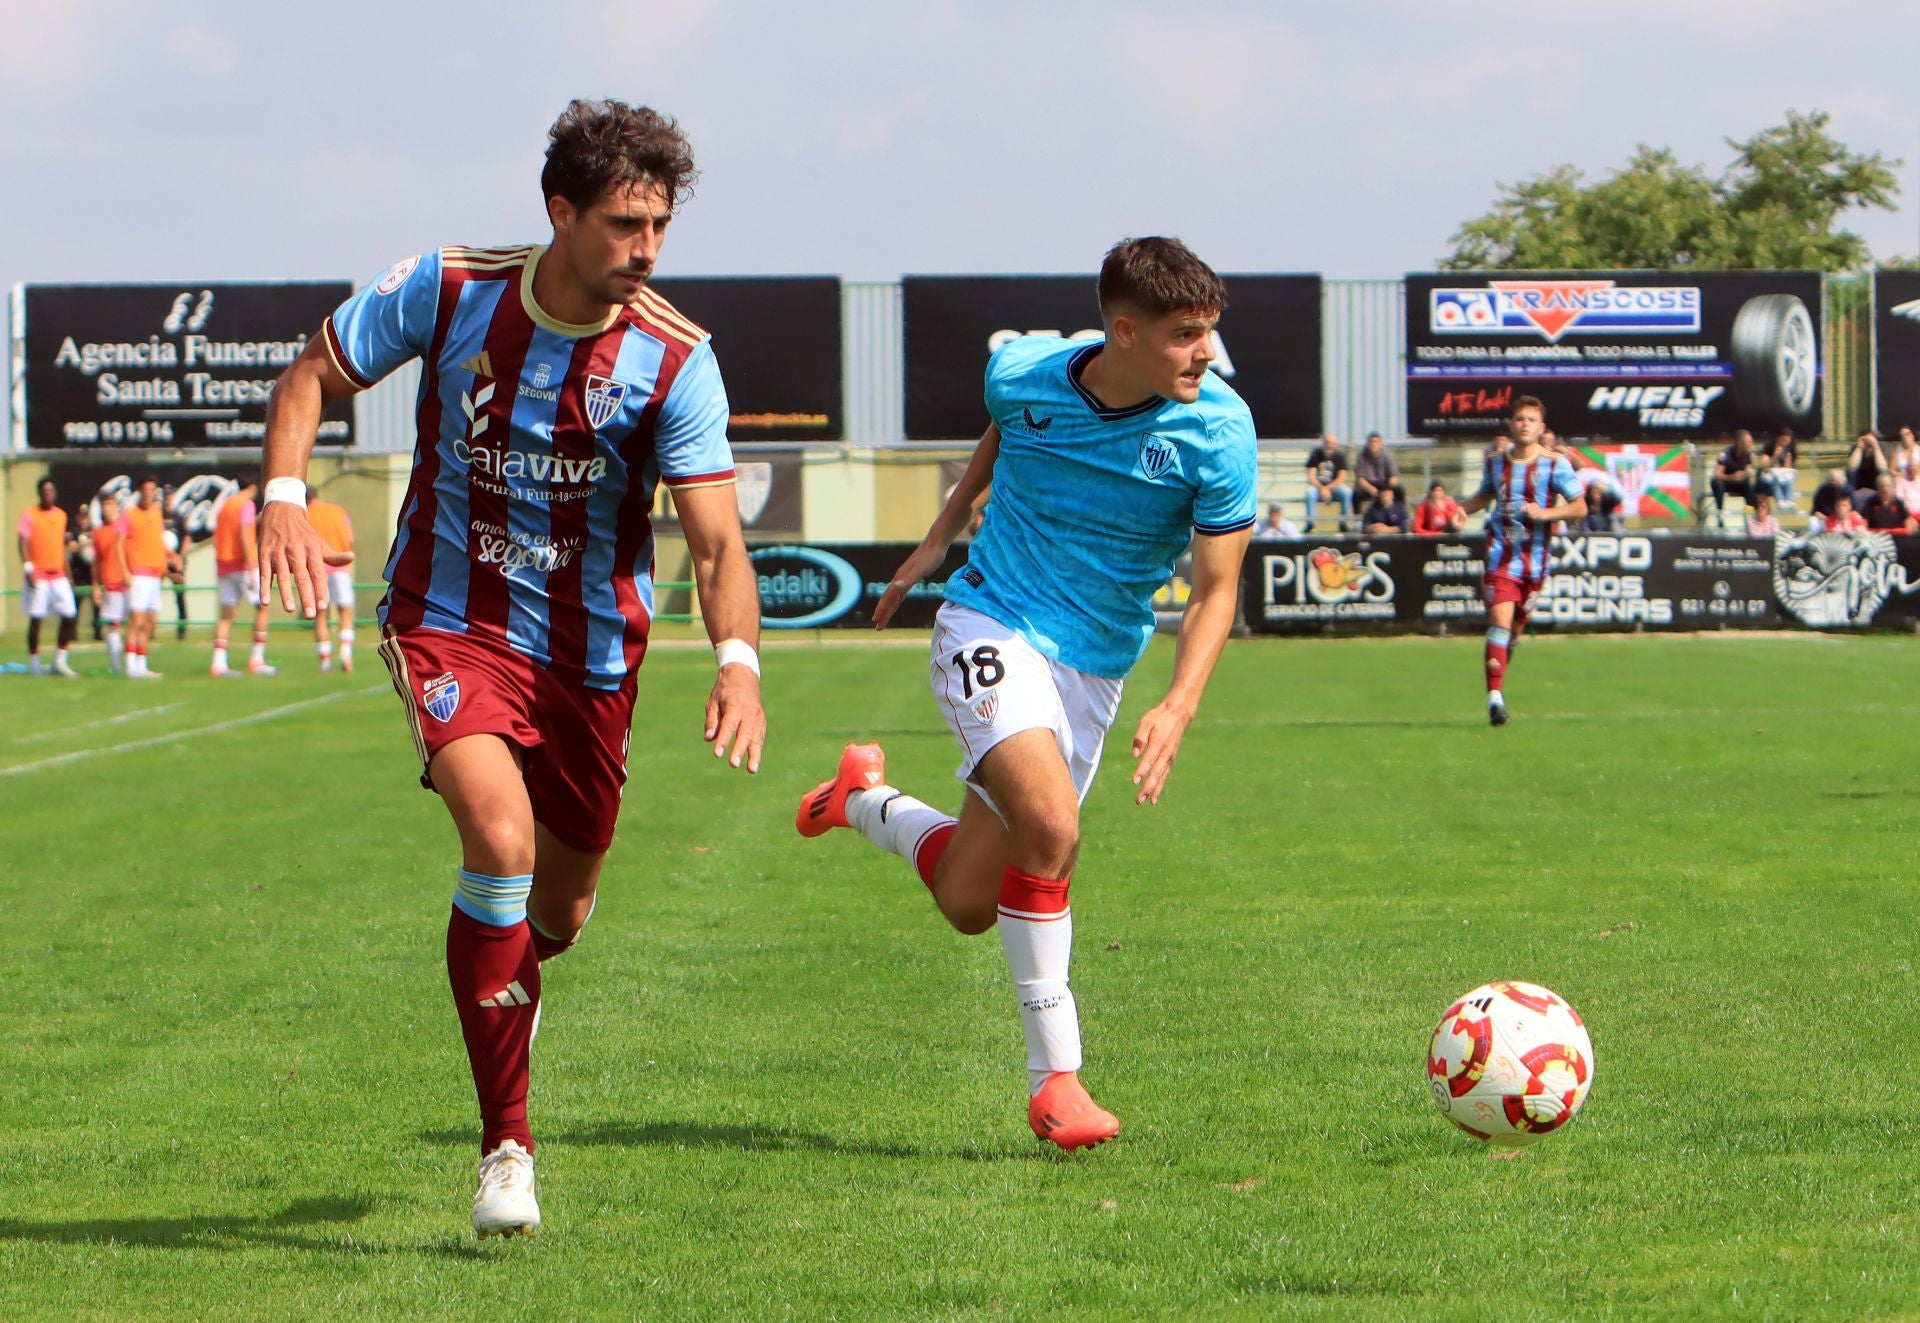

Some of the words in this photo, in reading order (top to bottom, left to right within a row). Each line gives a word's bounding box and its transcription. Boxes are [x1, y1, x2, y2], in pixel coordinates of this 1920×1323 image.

[1502, 289, 1696, 310] TRANSCOSE
[54, 335, 178, 376] Agencia
[183, 333, 307, 367] Funerari
[1415, 345, 1455, 360] TODO
[1455, 345, 1489, 360] PARA
[1489, 346, 1505, 360] EL
[1584, 345, 1622, 360] TODO
[1623, 345, 1656, 360] PARA
[1656, 346, 1671, 360] EL
[1672, 345, 1718, 360] TALLER
[96, 373, 180, 404] Santa
[518, 385, 557, 403] SEGOVIA
[1588, 386, 1725, 410] HIFLY
[1639, 408, 1705, 428] TIRES
[453, 439, 607, 483] cajaviva
[526, 486, 598, 502] Fundación
[534, 535, 553, 546] en
[758, 568, 828, 597] adalki
[1264, 604, 1319, 619] SERVICIO
[1320, 604, 1335, 618] DE
[1337, 602, 1397, 618] CATERING
[952, 645, 1006, 700] 18
